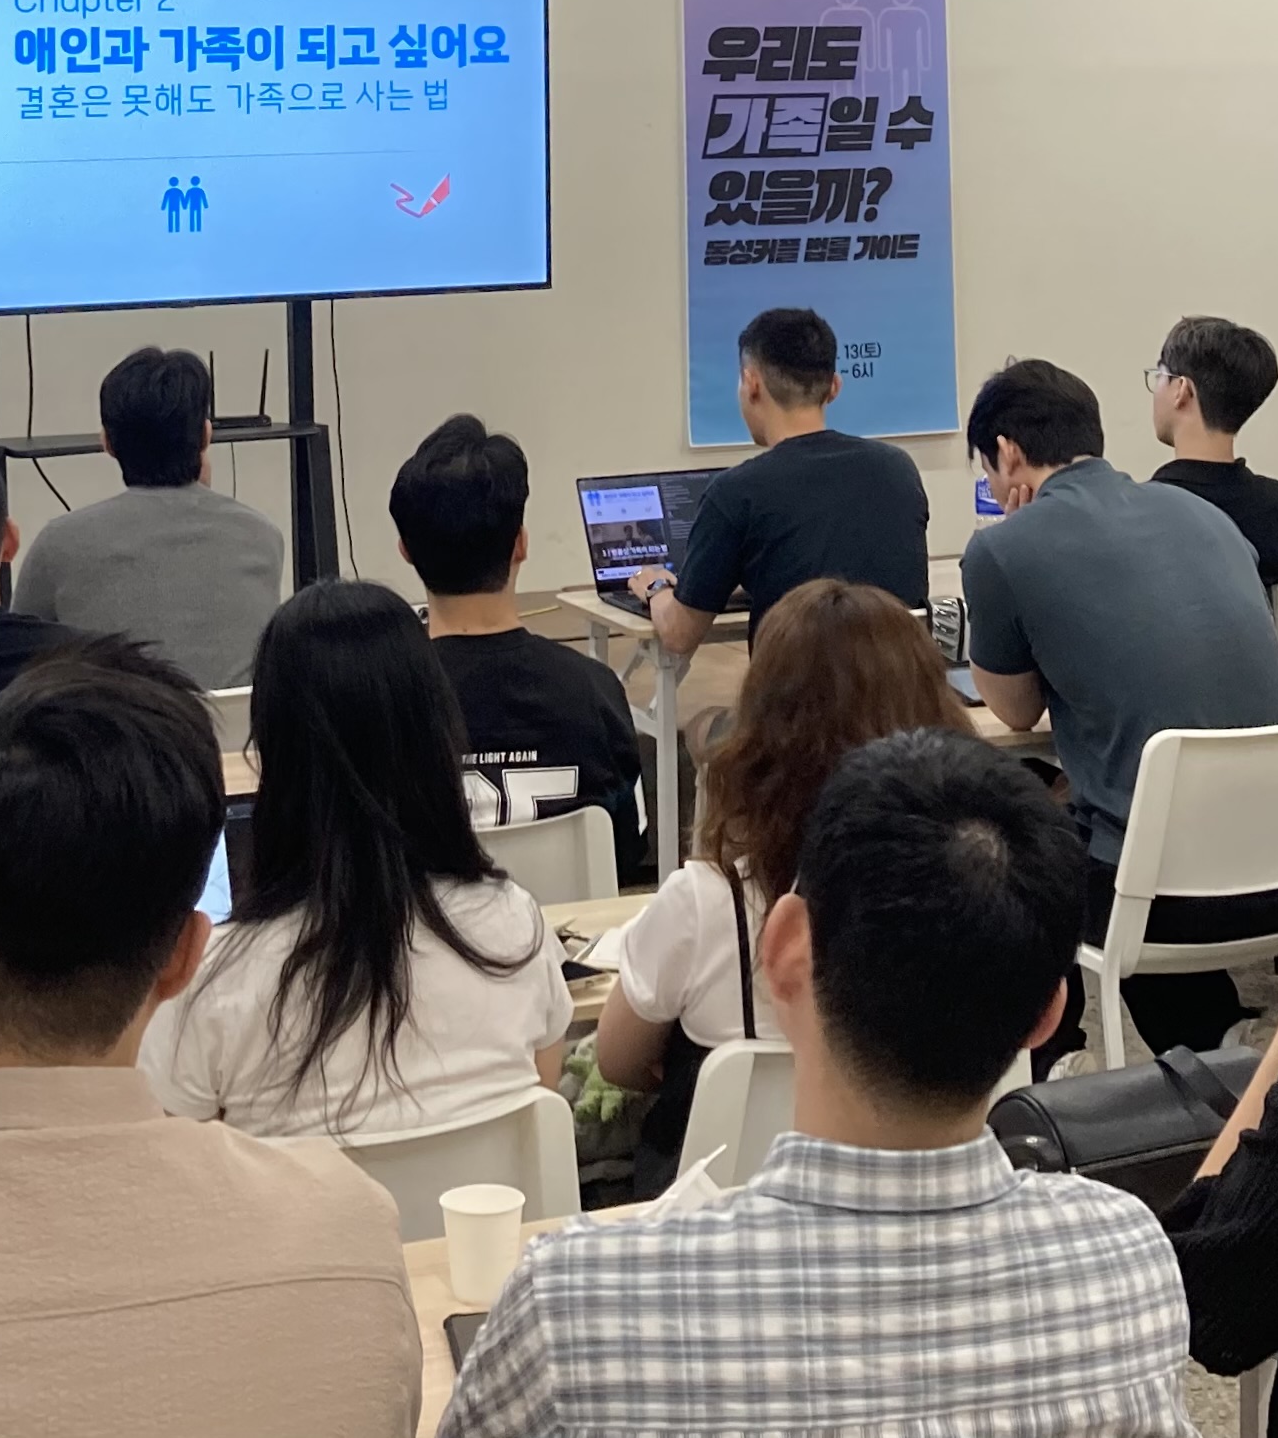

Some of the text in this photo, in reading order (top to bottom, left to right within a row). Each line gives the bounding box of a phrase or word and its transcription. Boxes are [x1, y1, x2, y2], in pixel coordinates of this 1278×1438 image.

[14, 22, 510, 75] 애인과 가족이 되고 싶어요
[702, 25, 862, 81] 우리도
[16, 78, 449, 120] 결혼은 못해도 가족으로 사는 법
[701, 93, 934, 159] 가족일 수
[704, 166, 892, 227] 있을까?
[703, 234, 920, 266] 동성커플 법률 가이드
[844, 342, 882, 360] 13(토)
[852, 362, 873, 379] 6시
[479, 751, 506, 764] LIGHT
[508, 750, 538, 762] AGAIN
